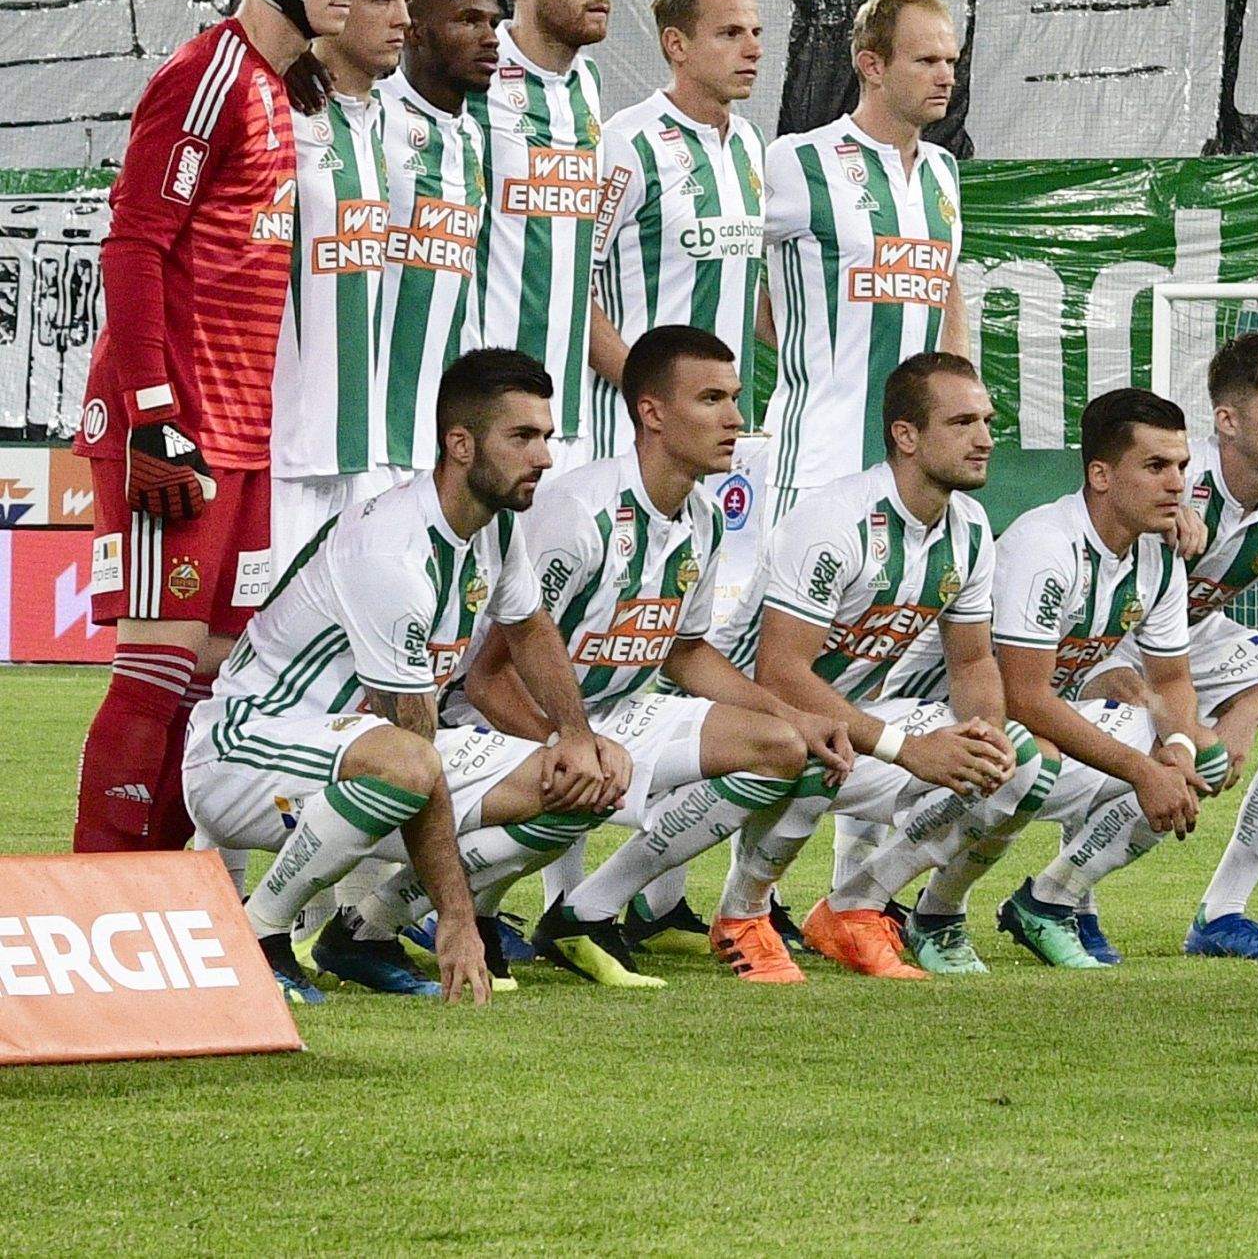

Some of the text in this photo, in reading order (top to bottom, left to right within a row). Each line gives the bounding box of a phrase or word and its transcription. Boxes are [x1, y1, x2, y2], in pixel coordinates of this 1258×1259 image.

[533, 153, 593, 182] WIEN
[507, 184, 598, 215] ENERGI
[386, 231, 473, 270] ENERG
[880, 242, 948, 271] WIEN
[578, 635, 675, 663] ENERGI
[0, 909, 240, 996] ERGIE
